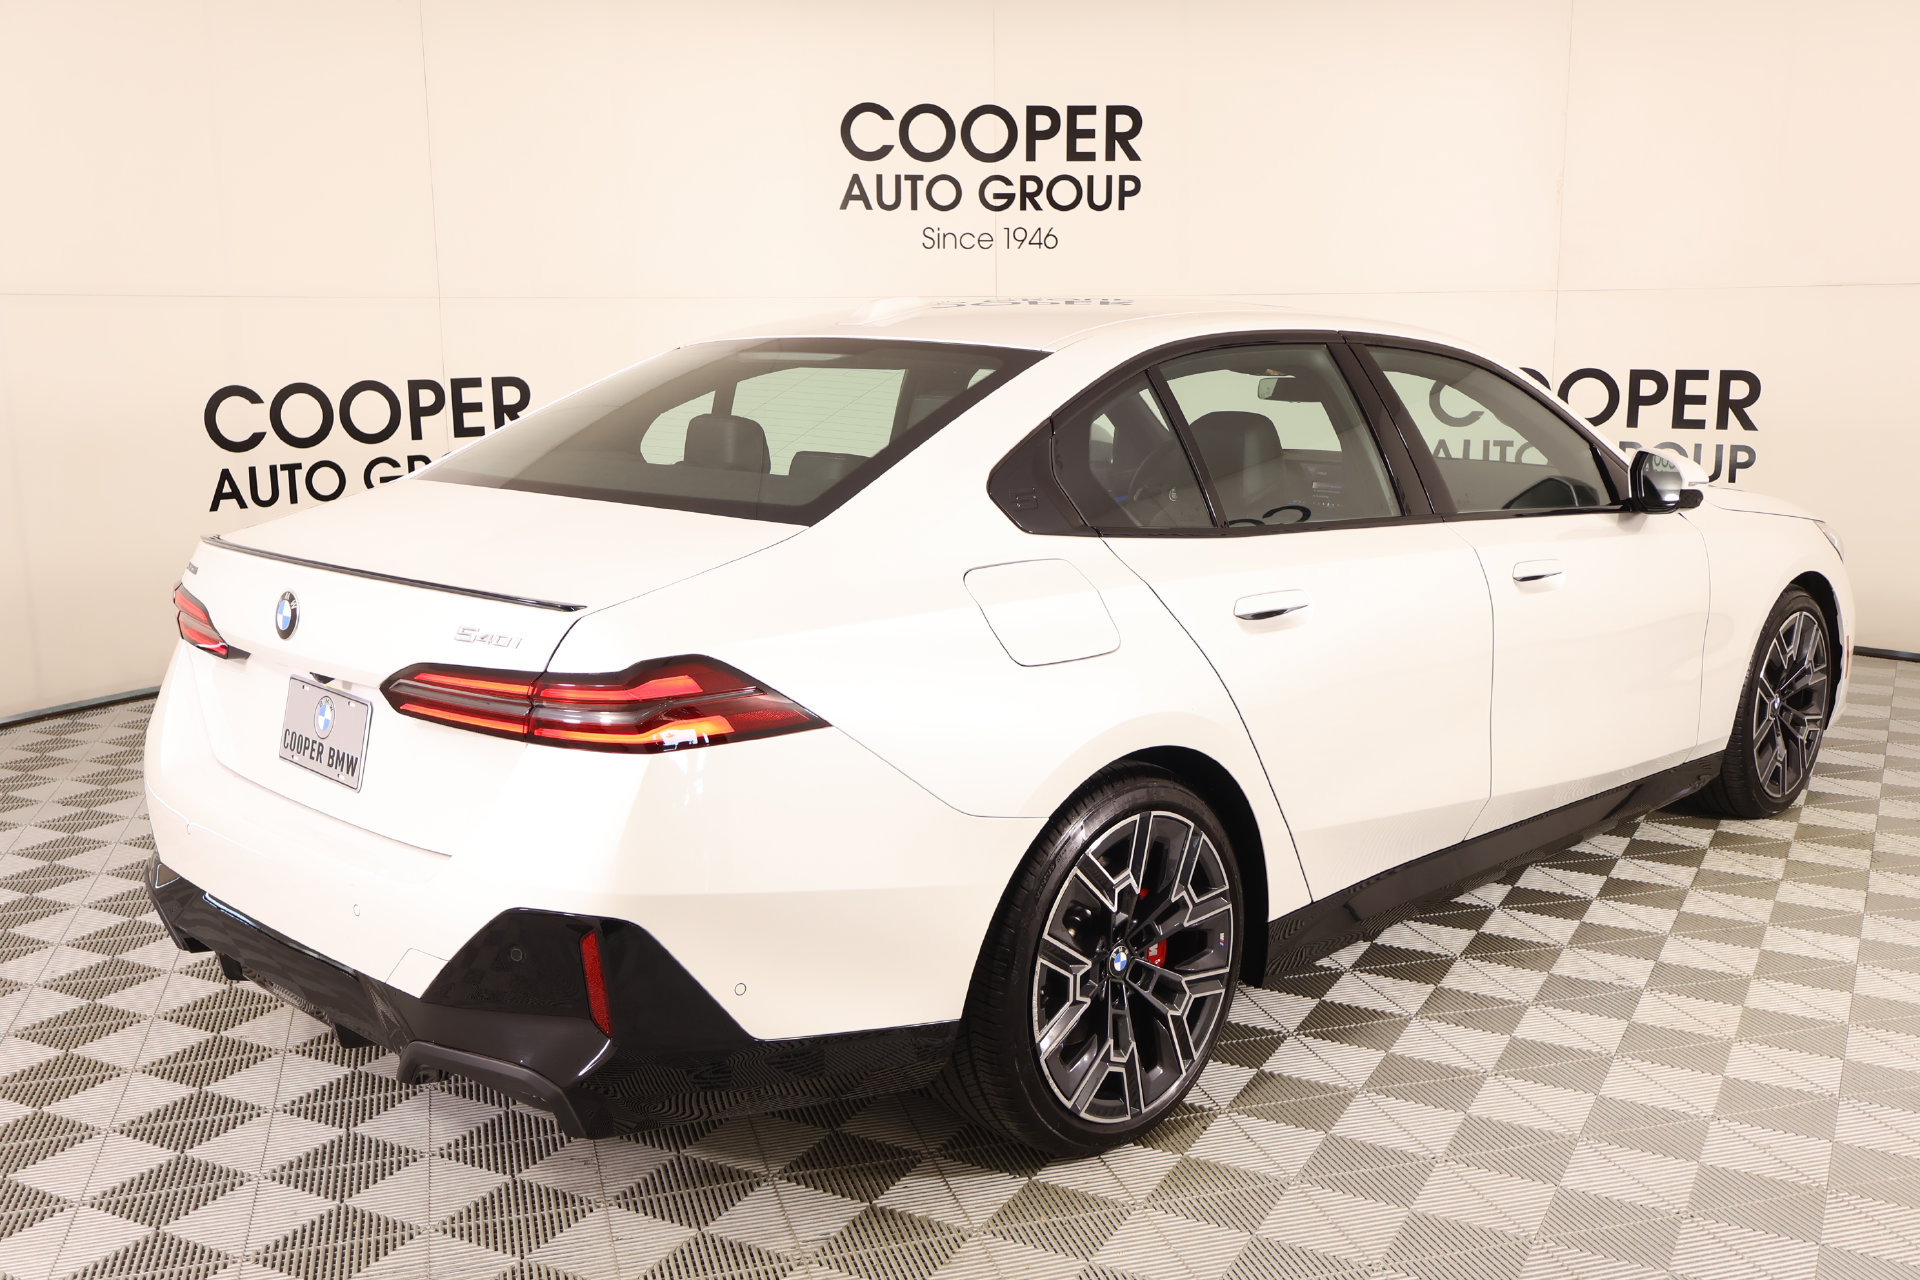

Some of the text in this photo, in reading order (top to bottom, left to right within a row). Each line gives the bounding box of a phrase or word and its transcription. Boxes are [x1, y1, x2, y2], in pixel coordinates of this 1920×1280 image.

[841, 102, 1142, 163] COOPER
[840, 174, 1141, 212] AUTO GROUP
[923, 227, 1058, 249] Since 1946
[204, 376, 532, 453] COOPER
[209, 460, 346, 512] AUTO
[454, 626, 523, 649] 540i
[283, 728, 358, 777] COOPER BMW
